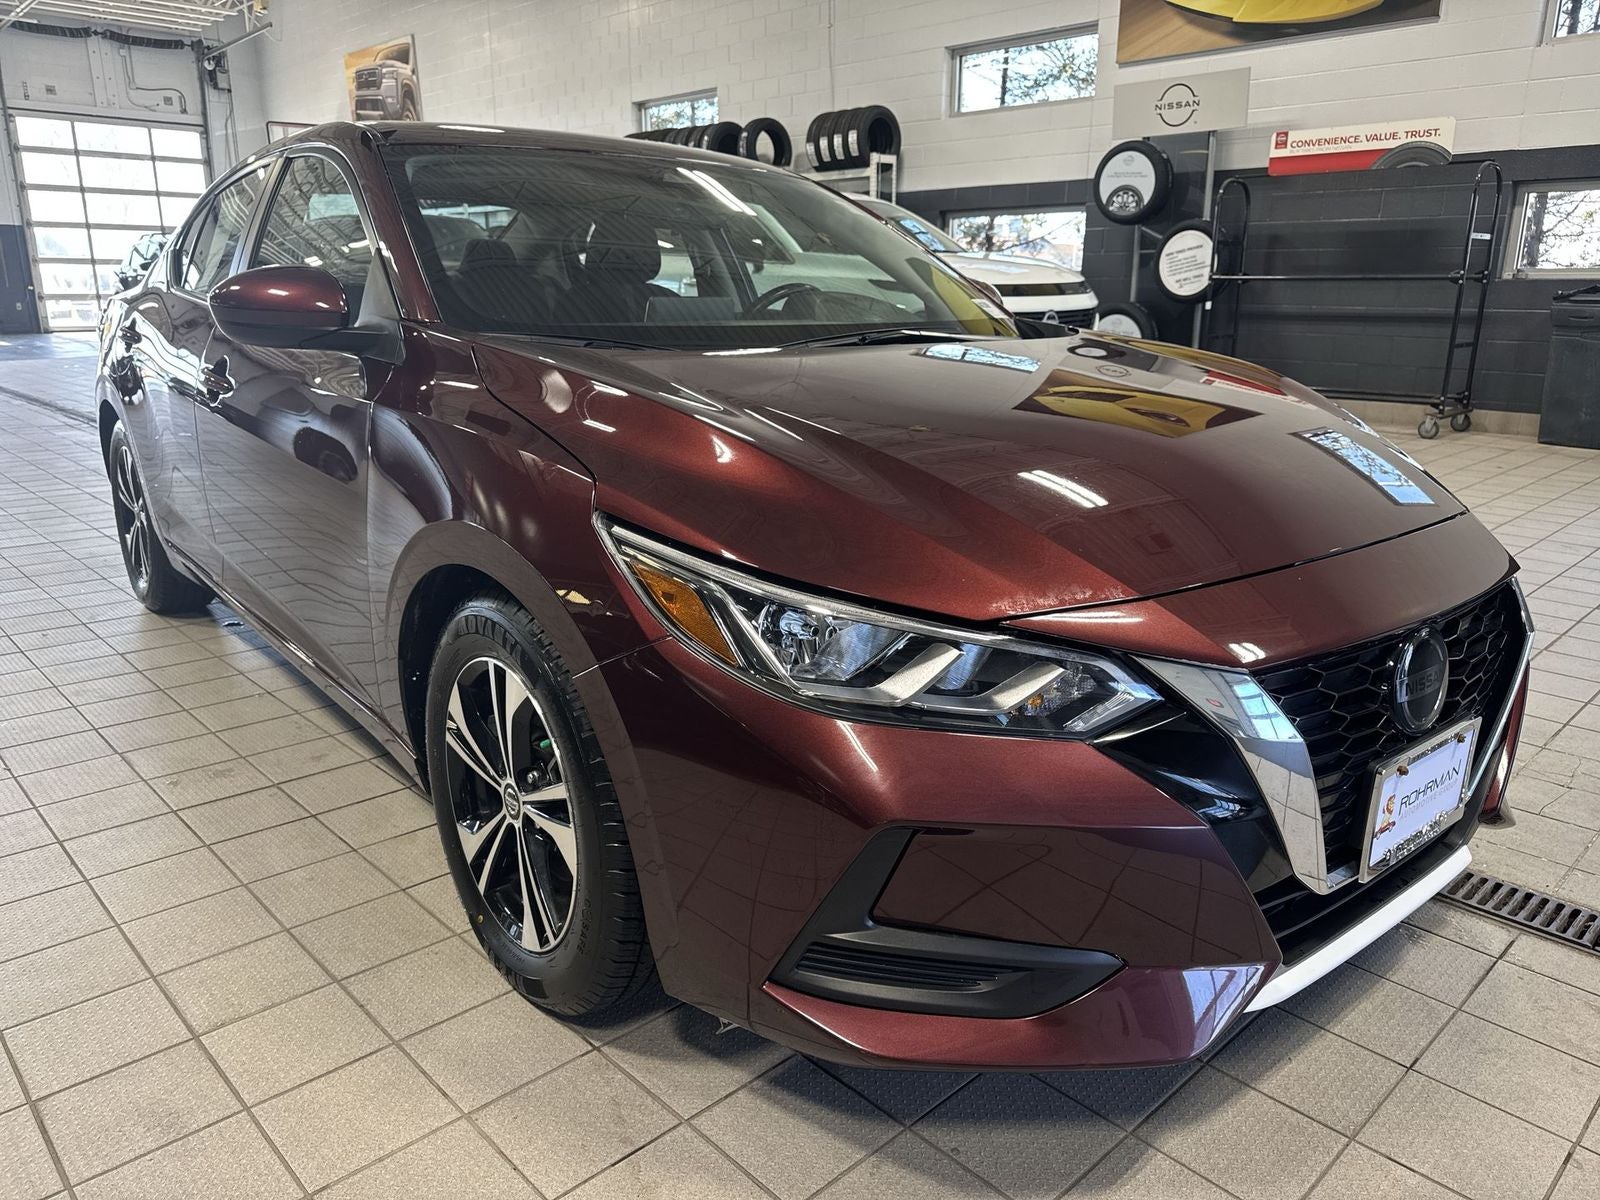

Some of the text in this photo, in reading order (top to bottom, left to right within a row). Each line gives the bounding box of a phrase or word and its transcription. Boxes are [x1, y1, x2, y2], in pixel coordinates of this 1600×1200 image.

[1154, 99, 1200, 111] NISSAN
[1290, 134, 1363, 149] CONVENIENCE.
[1365, 131, 1402, 142] VALUE.
[1404, 128, 1441, 139] TRUST.
[1398, 759, 1462, 816] ROHRMAN
